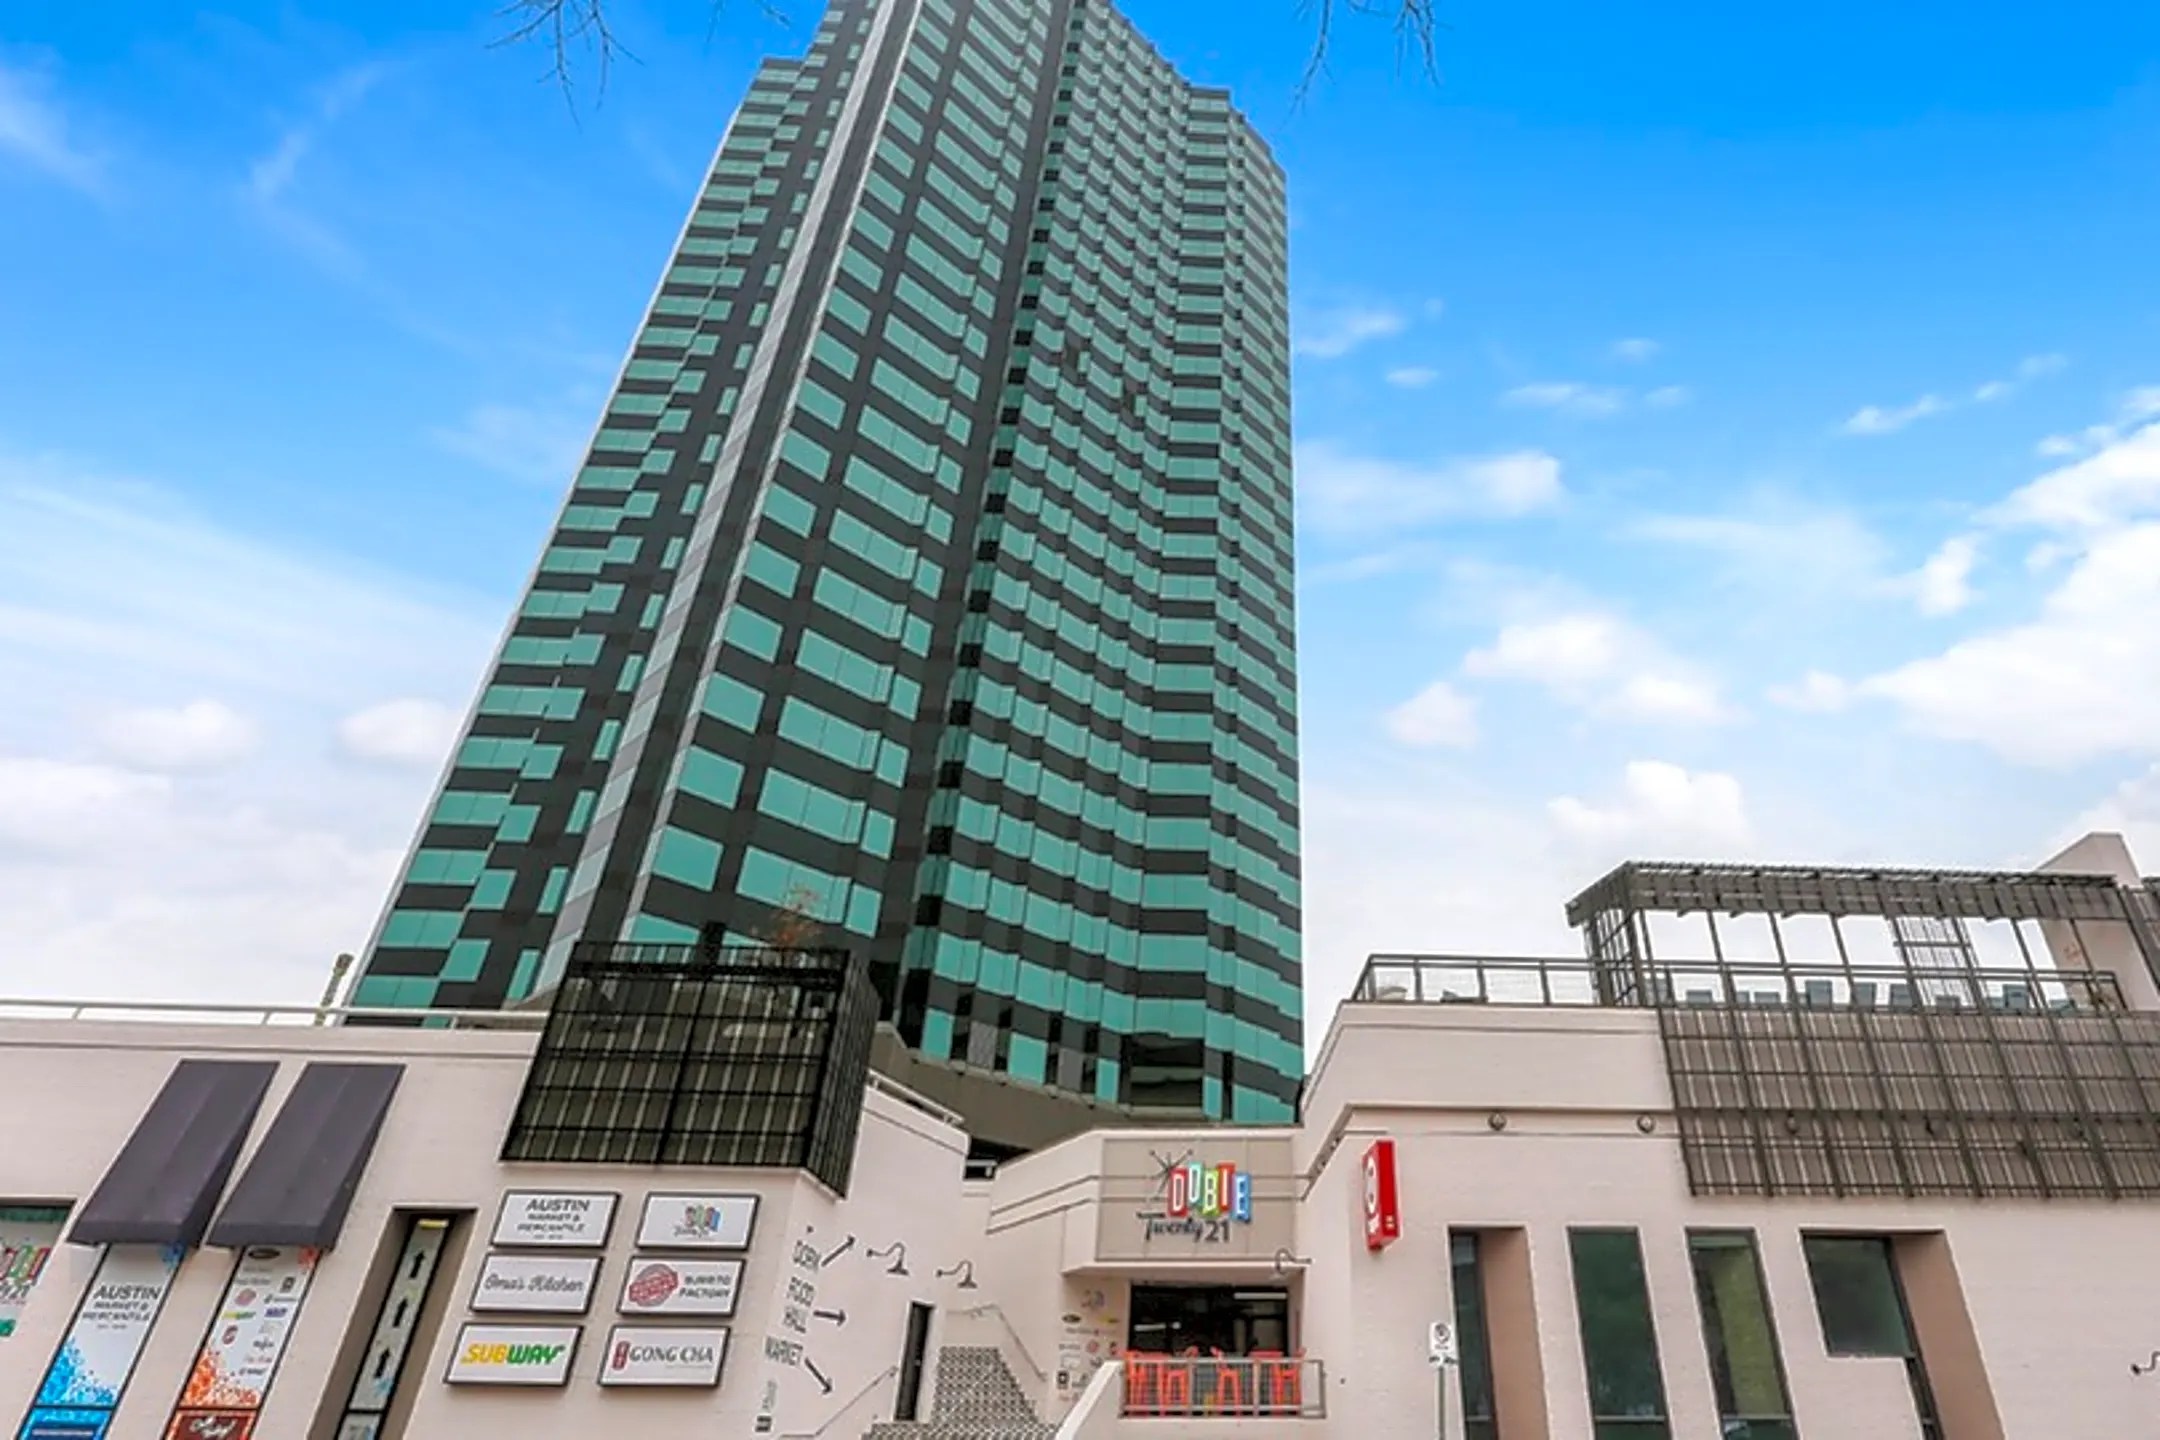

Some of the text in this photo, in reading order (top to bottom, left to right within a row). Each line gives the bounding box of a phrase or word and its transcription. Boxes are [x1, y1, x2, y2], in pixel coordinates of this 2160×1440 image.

[1168, 1161, 1251, 1222] DOBIE
[526, 1198, 590, 1212] AUSTIN
[93, 1285, 163, 1300] AUSTIN
[461, 1343, 566, 1364] SUBWAY
[630, 1346, 679, 1362] GONG
